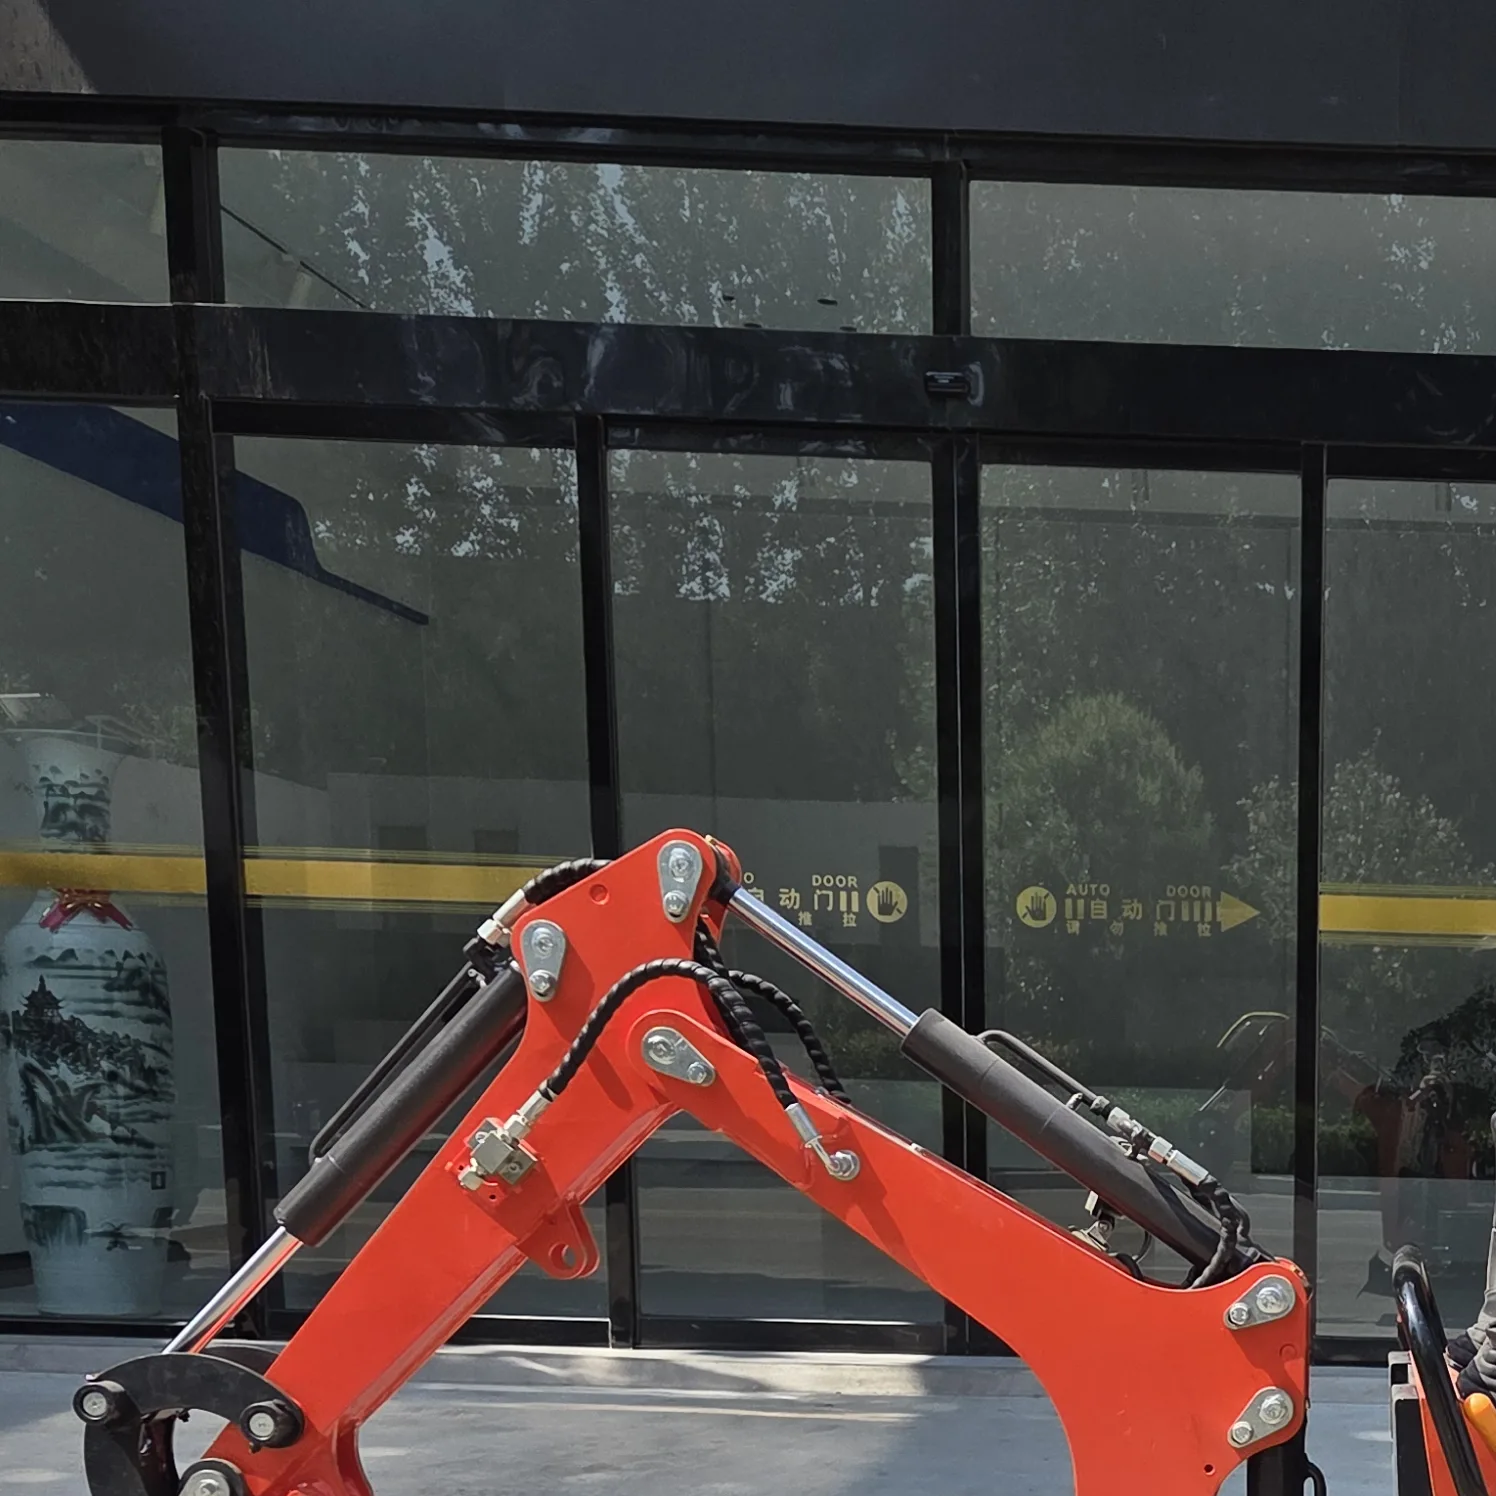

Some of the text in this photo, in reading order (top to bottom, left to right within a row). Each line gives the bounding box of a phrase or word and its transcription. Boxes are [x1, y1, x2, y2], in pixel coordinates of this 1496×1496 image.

[812, 874, 858, 888] DOOR
[1066, 883, 1212, 898] AUTO DOOR
